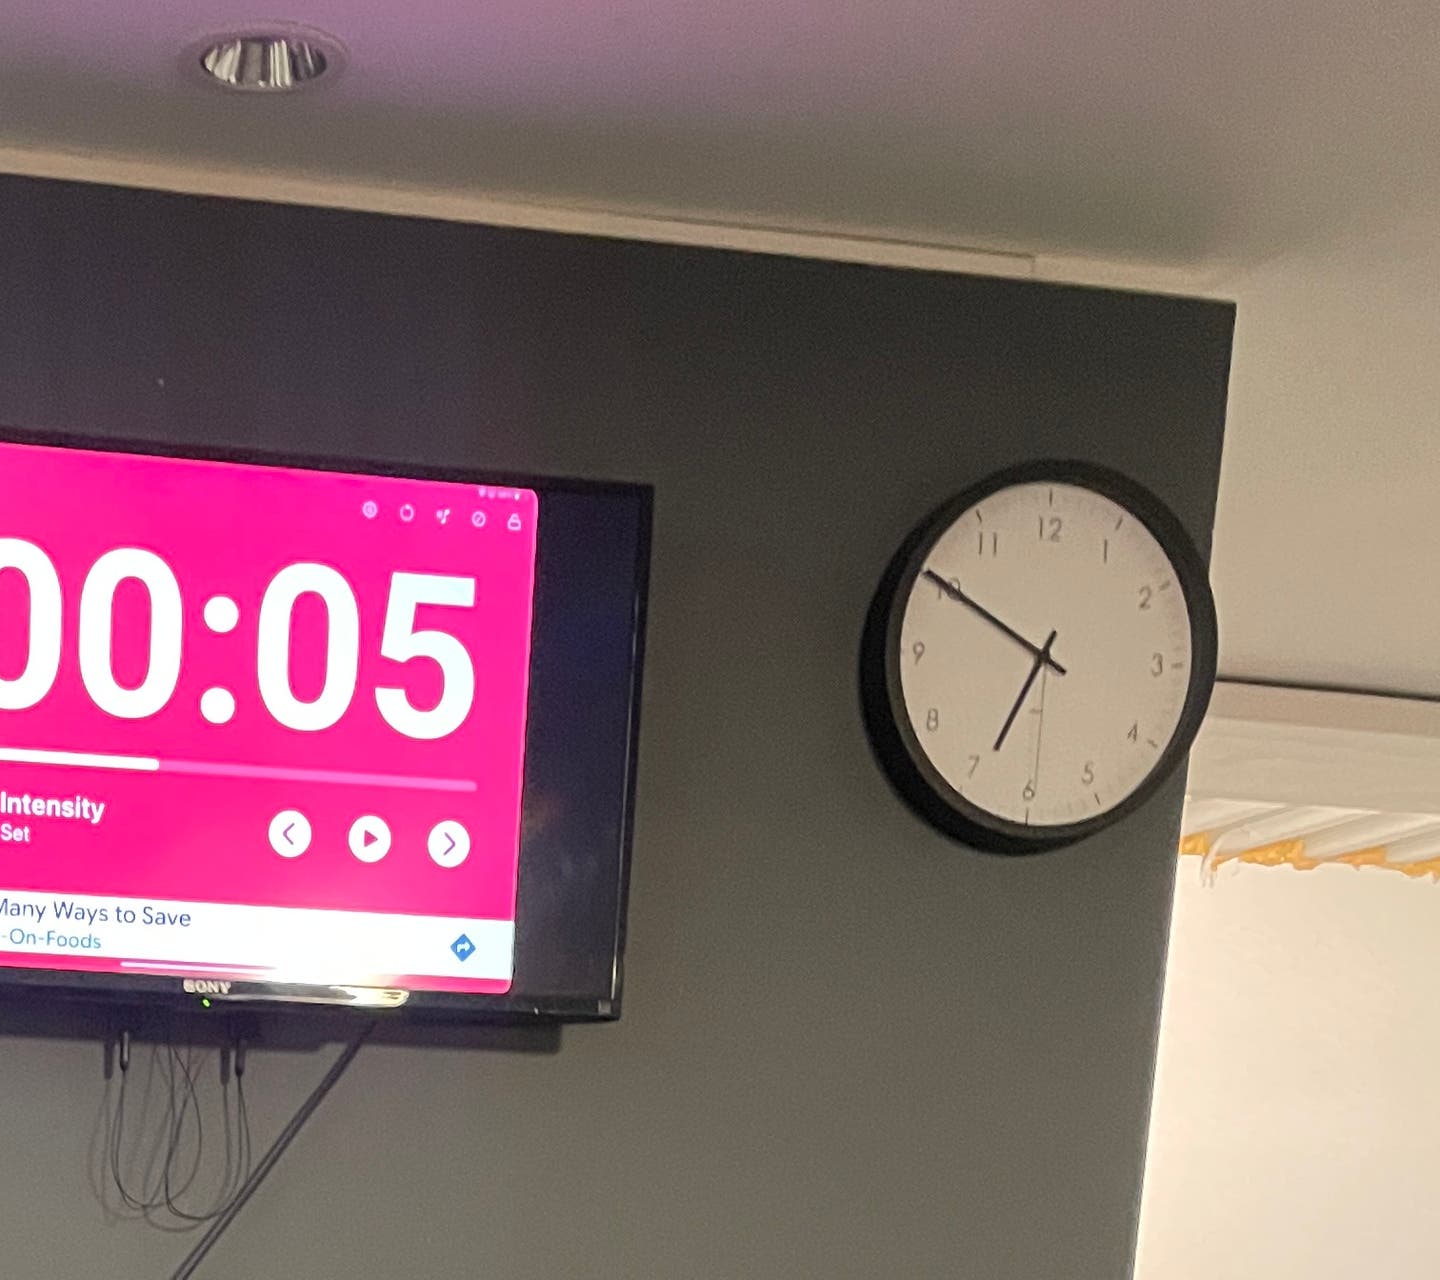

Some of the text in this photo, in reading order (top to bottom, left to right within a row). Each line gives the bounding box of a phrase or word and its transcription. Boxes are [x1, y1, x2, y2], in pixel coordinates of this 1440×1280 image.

[1038, 515, 1061, 542] 12
[977, 532, 998, 558] 11
[1137, 586, 1152, 611] 2
[912, 641, 926, 666] 9
[1150, 651, 1164, 677] 3
[925, 707, 939, 732] 8
[1126, 724, 1139, 743] 4
[967, 754, 980, 778] 7
[1081, 761, 1094, 785] 5
[1022, 779, 1037, 803] 6
[0, 791, 105, 824] Intensity
[0, 823, 30, 842] Set
[54, 901, 108, 926] Ways
[115, 904, 136, 924] to
[142, 907, 191, 927] Save
[182, 979, 232, 995] SONY
